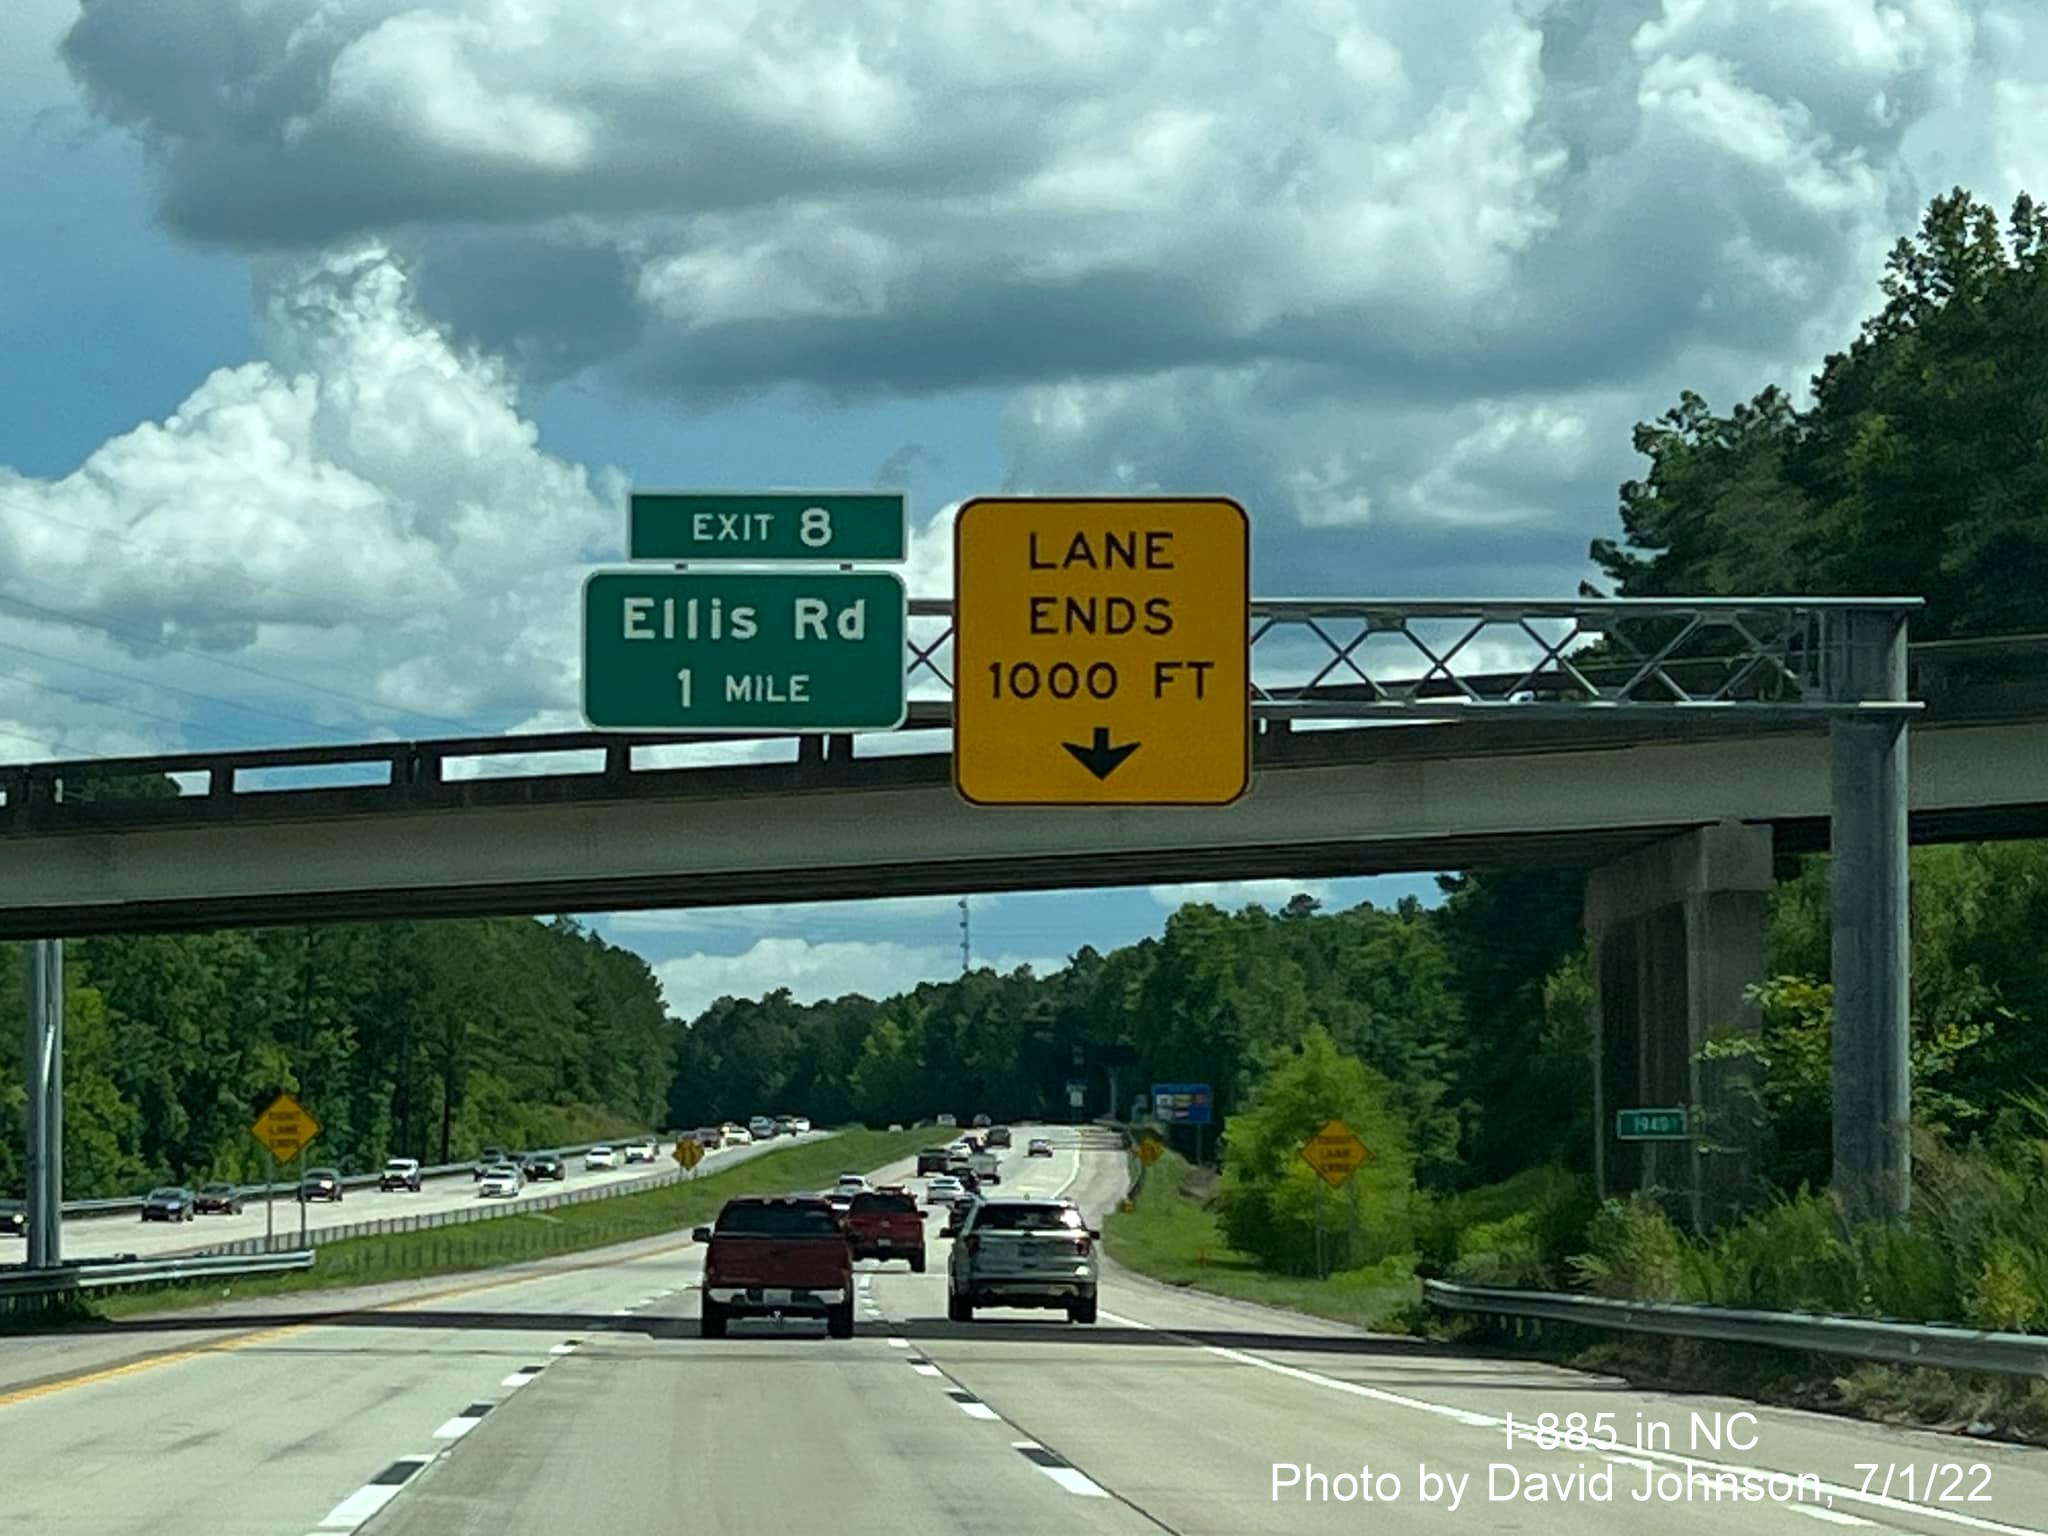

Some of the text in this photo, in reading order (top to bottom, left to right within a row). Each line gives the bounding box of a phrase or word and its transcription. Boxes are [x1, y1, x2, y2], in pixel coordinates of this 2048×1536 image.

[692, 507, 832, 547] EXIT 8
[1028, 530, 1175, 571] LANE
[623, 597, 866, 640] Ellis Rd
[1029, 596, 1175, 636] ENDS
[677, 668, 810, 708] 1 MILE
[988, 660, 1216, 701] 1000 FT
